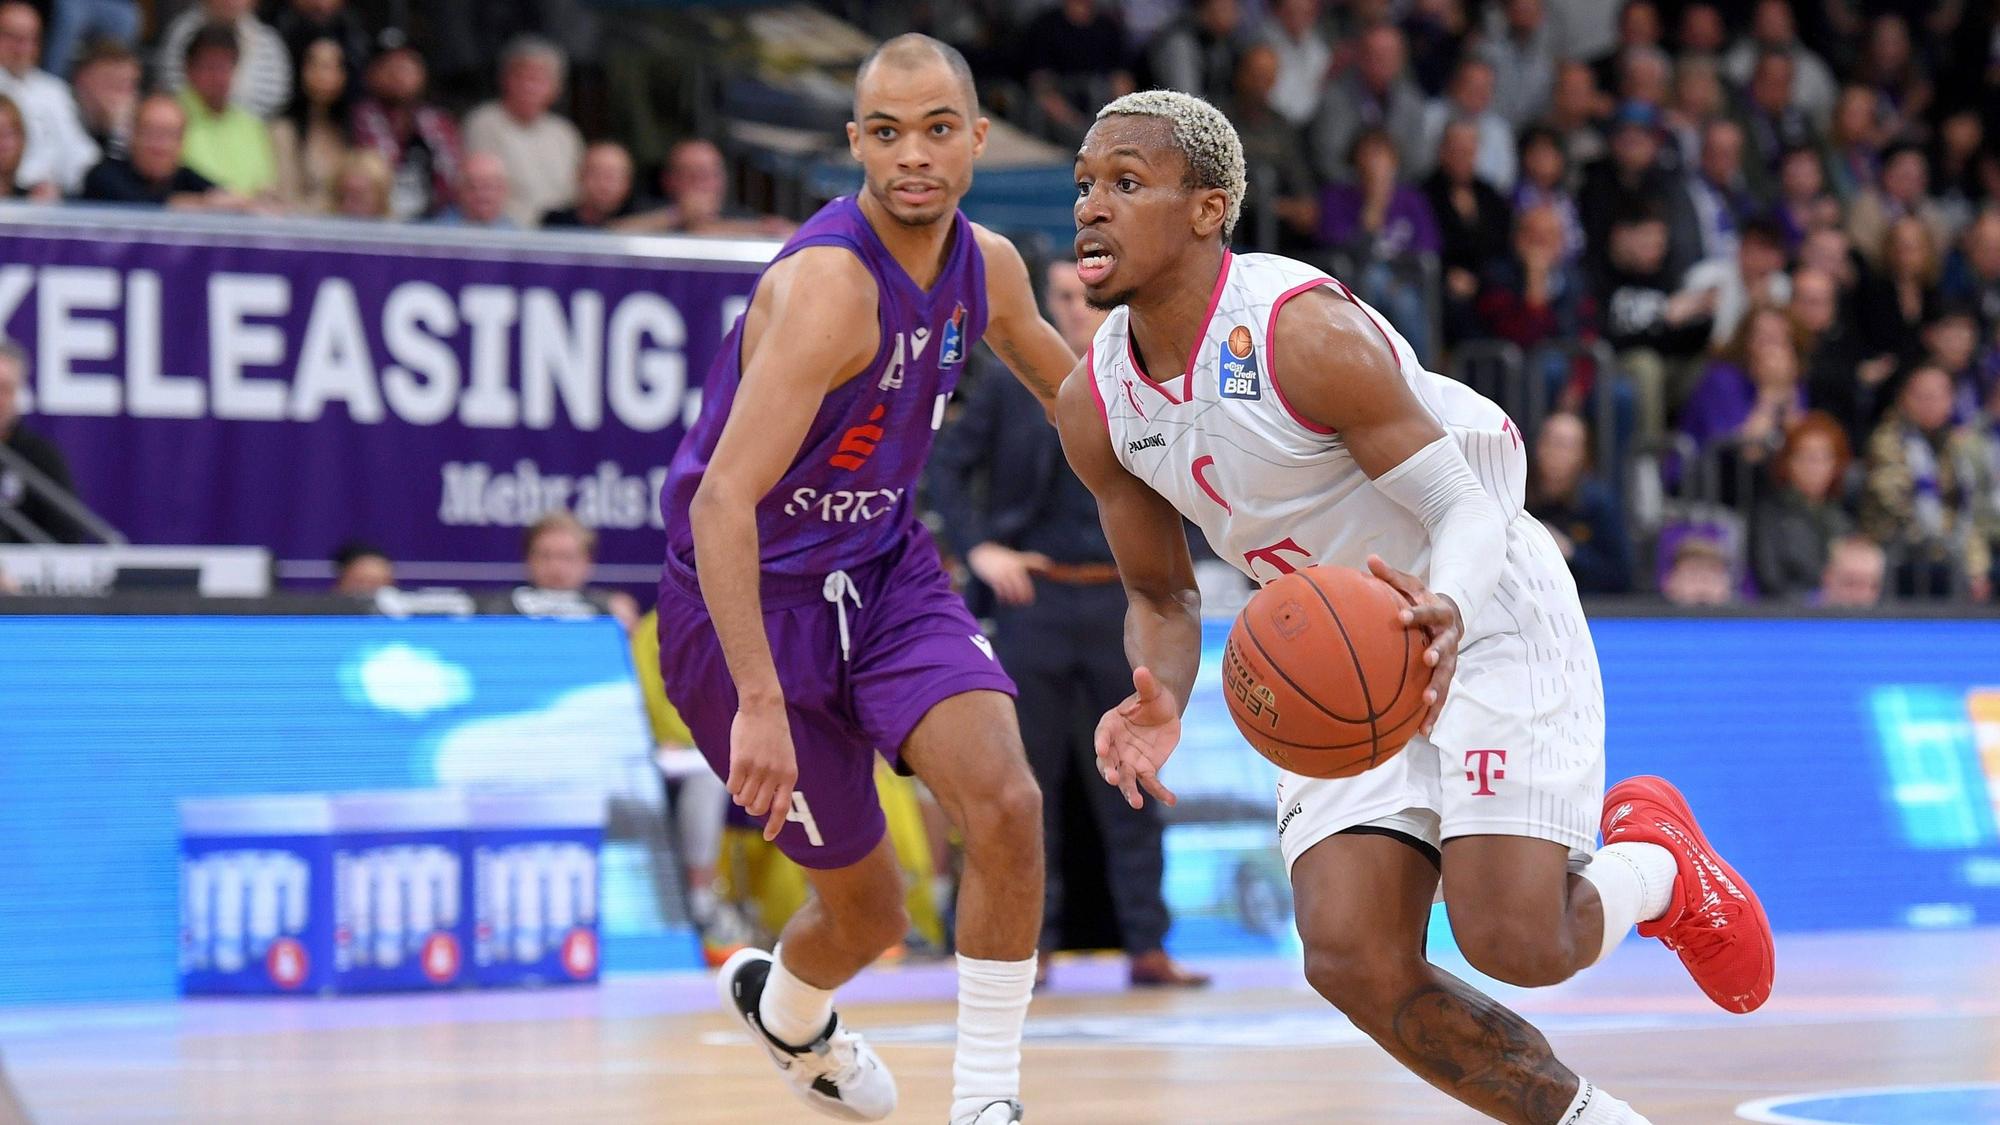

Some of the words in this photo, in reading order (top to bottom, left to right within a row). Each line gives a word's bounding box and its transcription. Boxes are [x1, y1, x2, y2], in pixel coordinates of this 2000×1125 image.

[0, 264, 747, 432] ELEASING.
[1224, 378, 1257, 395] BBL
[1128, 432, 1167, 454] PALDING
